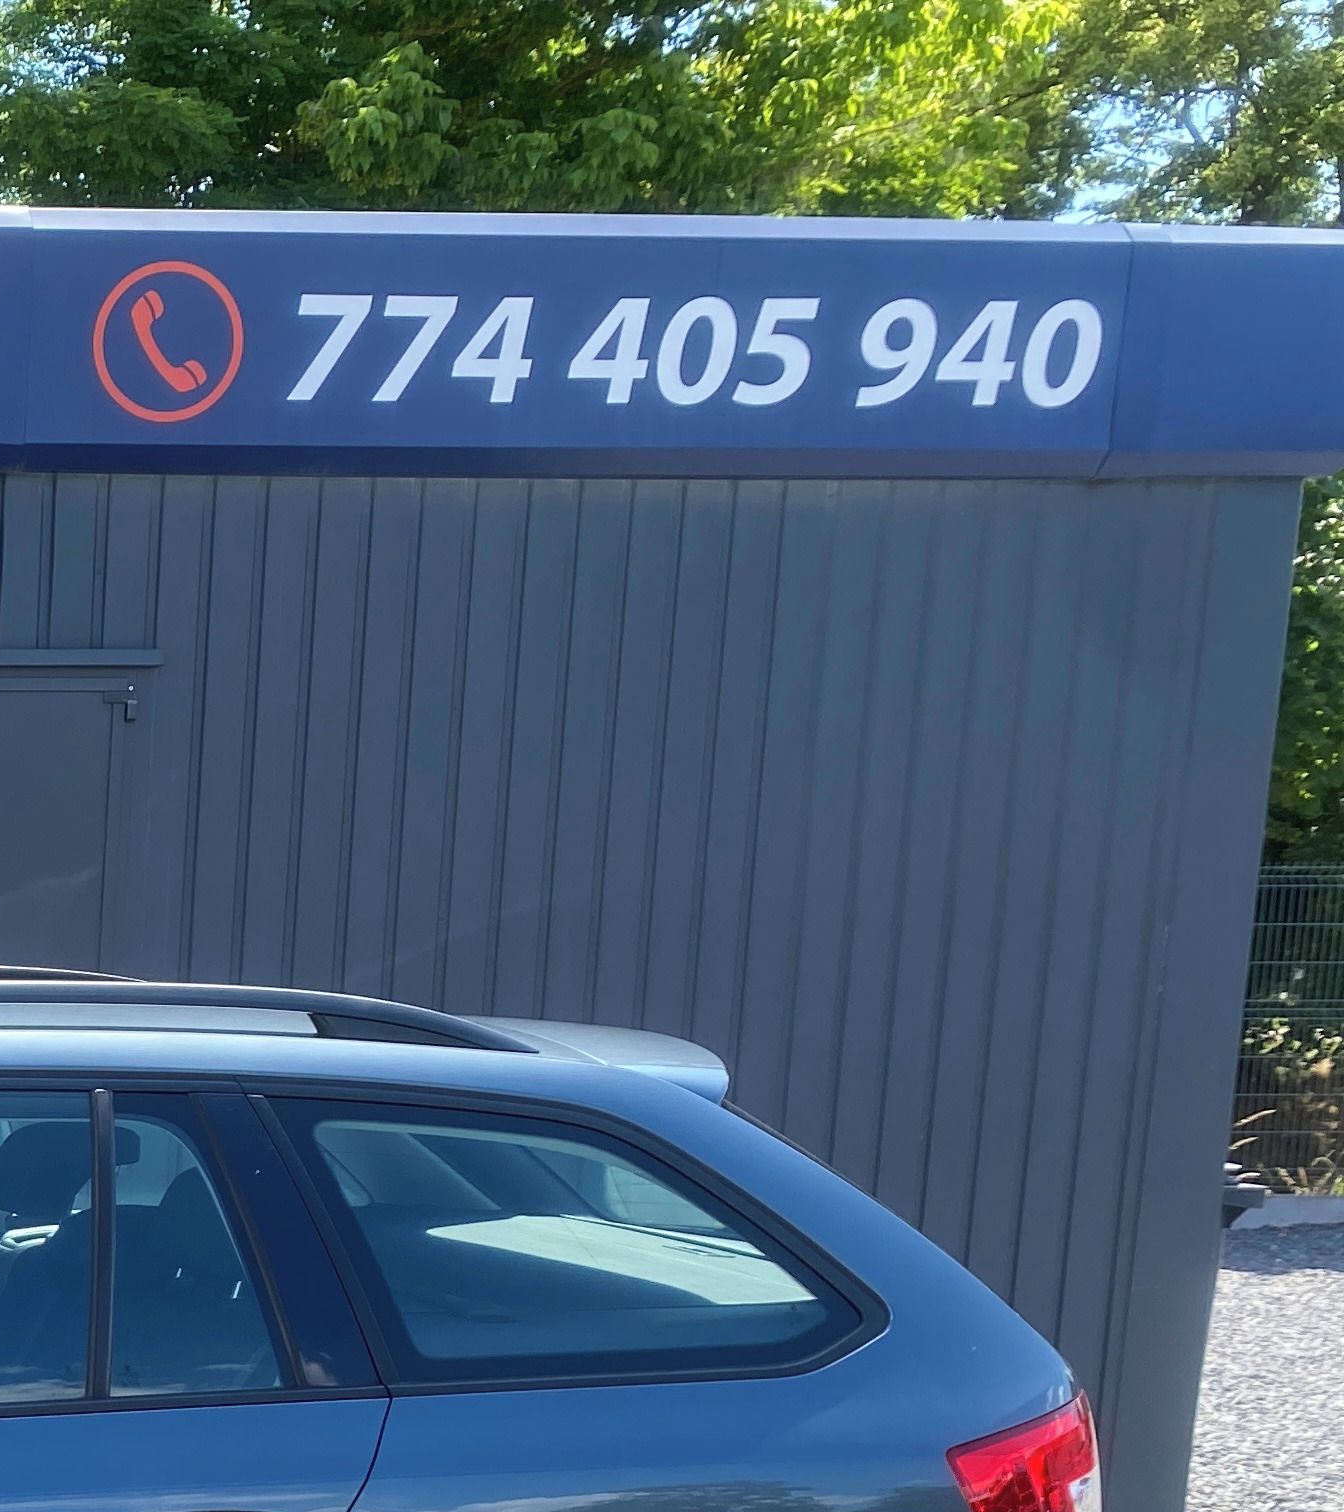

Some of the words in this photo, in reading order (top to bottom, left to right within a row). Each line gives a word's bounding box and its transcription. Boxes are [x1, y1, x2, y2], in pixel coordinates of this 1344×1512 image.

[287, 294, 533, 402] 774
[568, 297, 819, 405] 405
[856, 299, 1101, 407] 940
